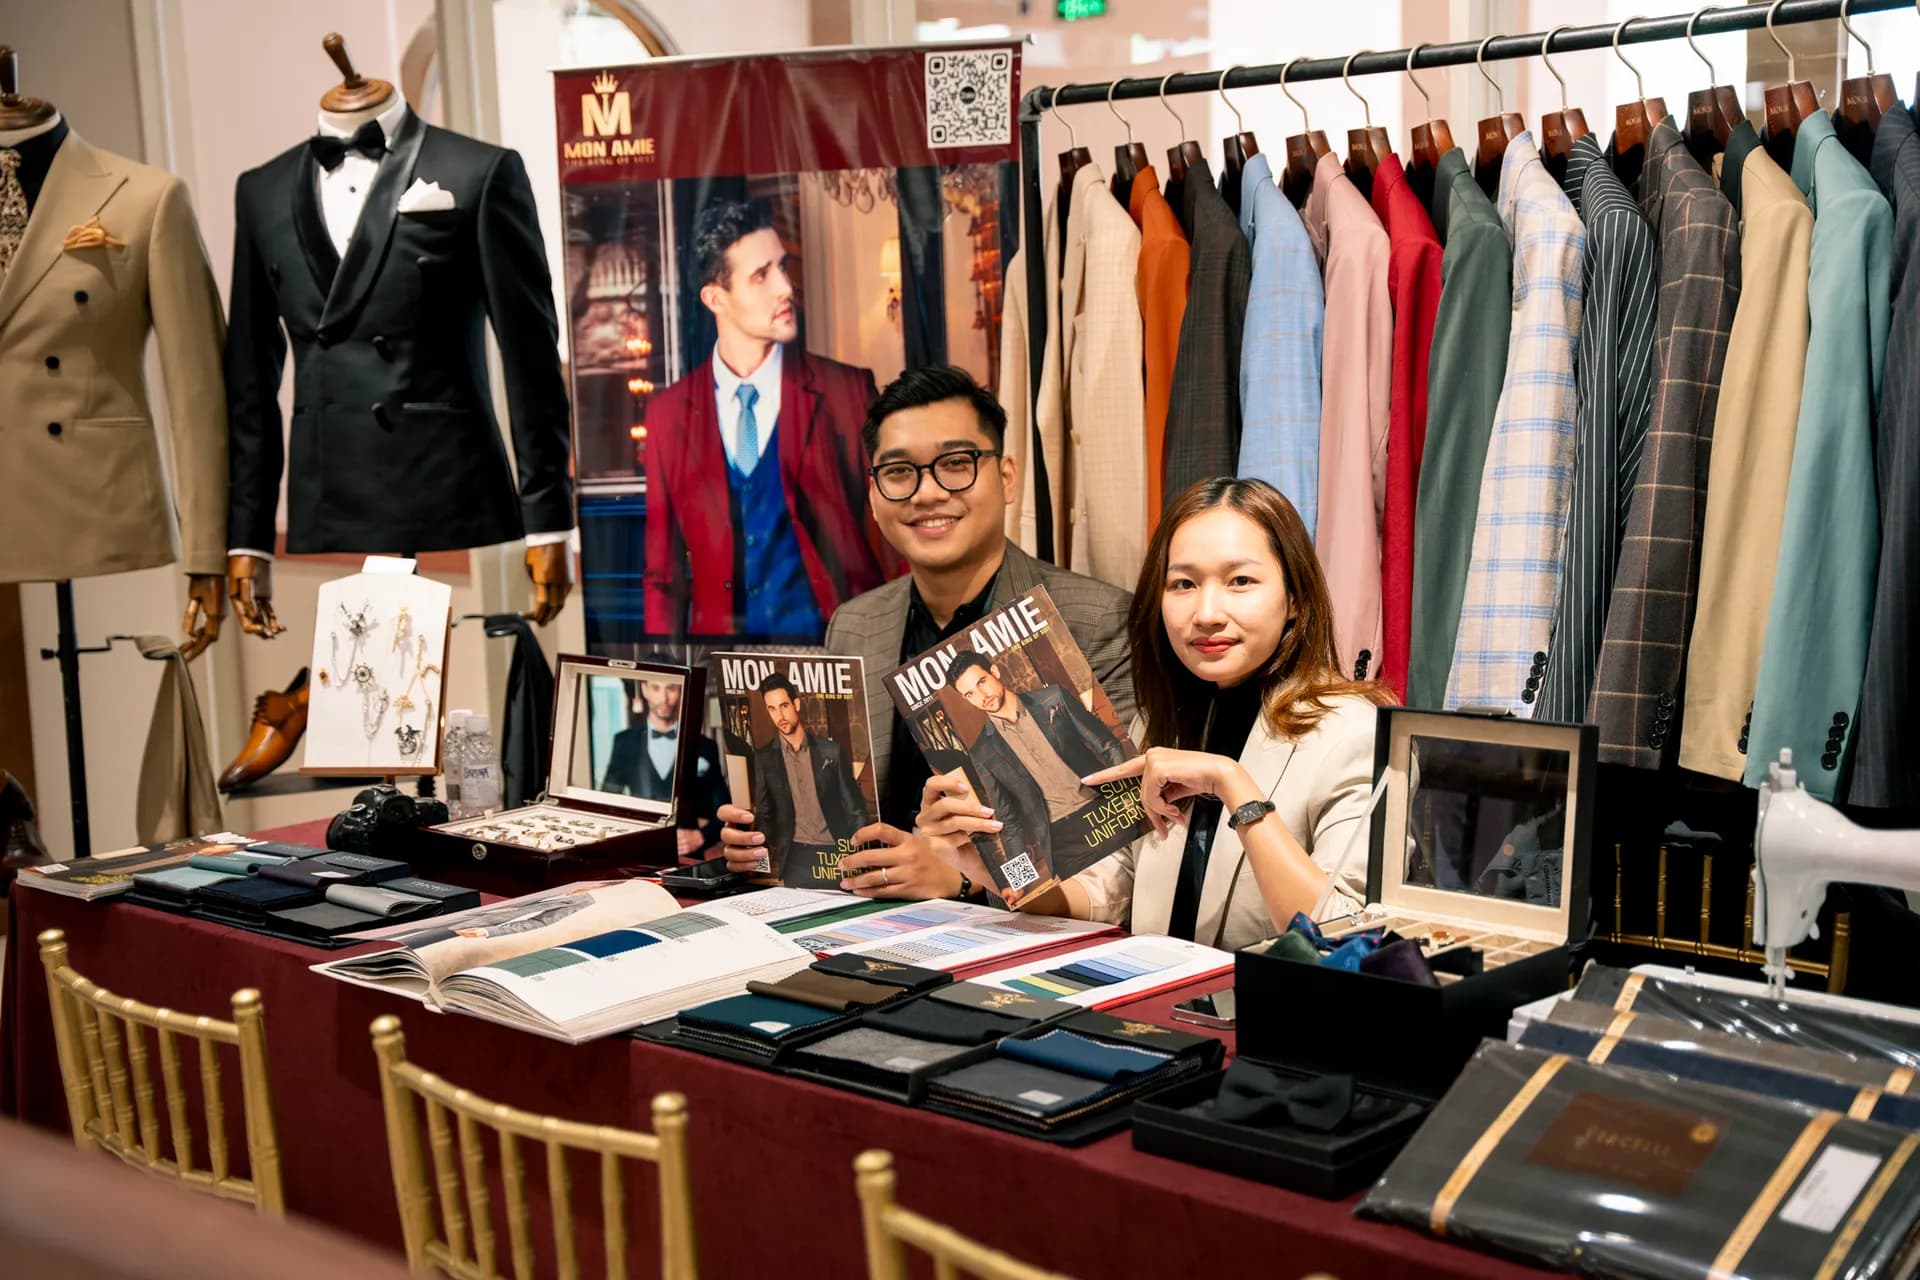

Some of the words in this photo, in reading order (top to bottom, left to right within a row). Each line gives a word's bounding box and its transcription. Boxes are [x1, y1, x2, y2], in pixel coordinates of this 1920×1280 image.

[564, 141, 606, 158] MON
[612, 138, 655, 156] AMIE
[969, 595, 1049, 658] AMIE
[788, 661, 853, 694] AMIE
